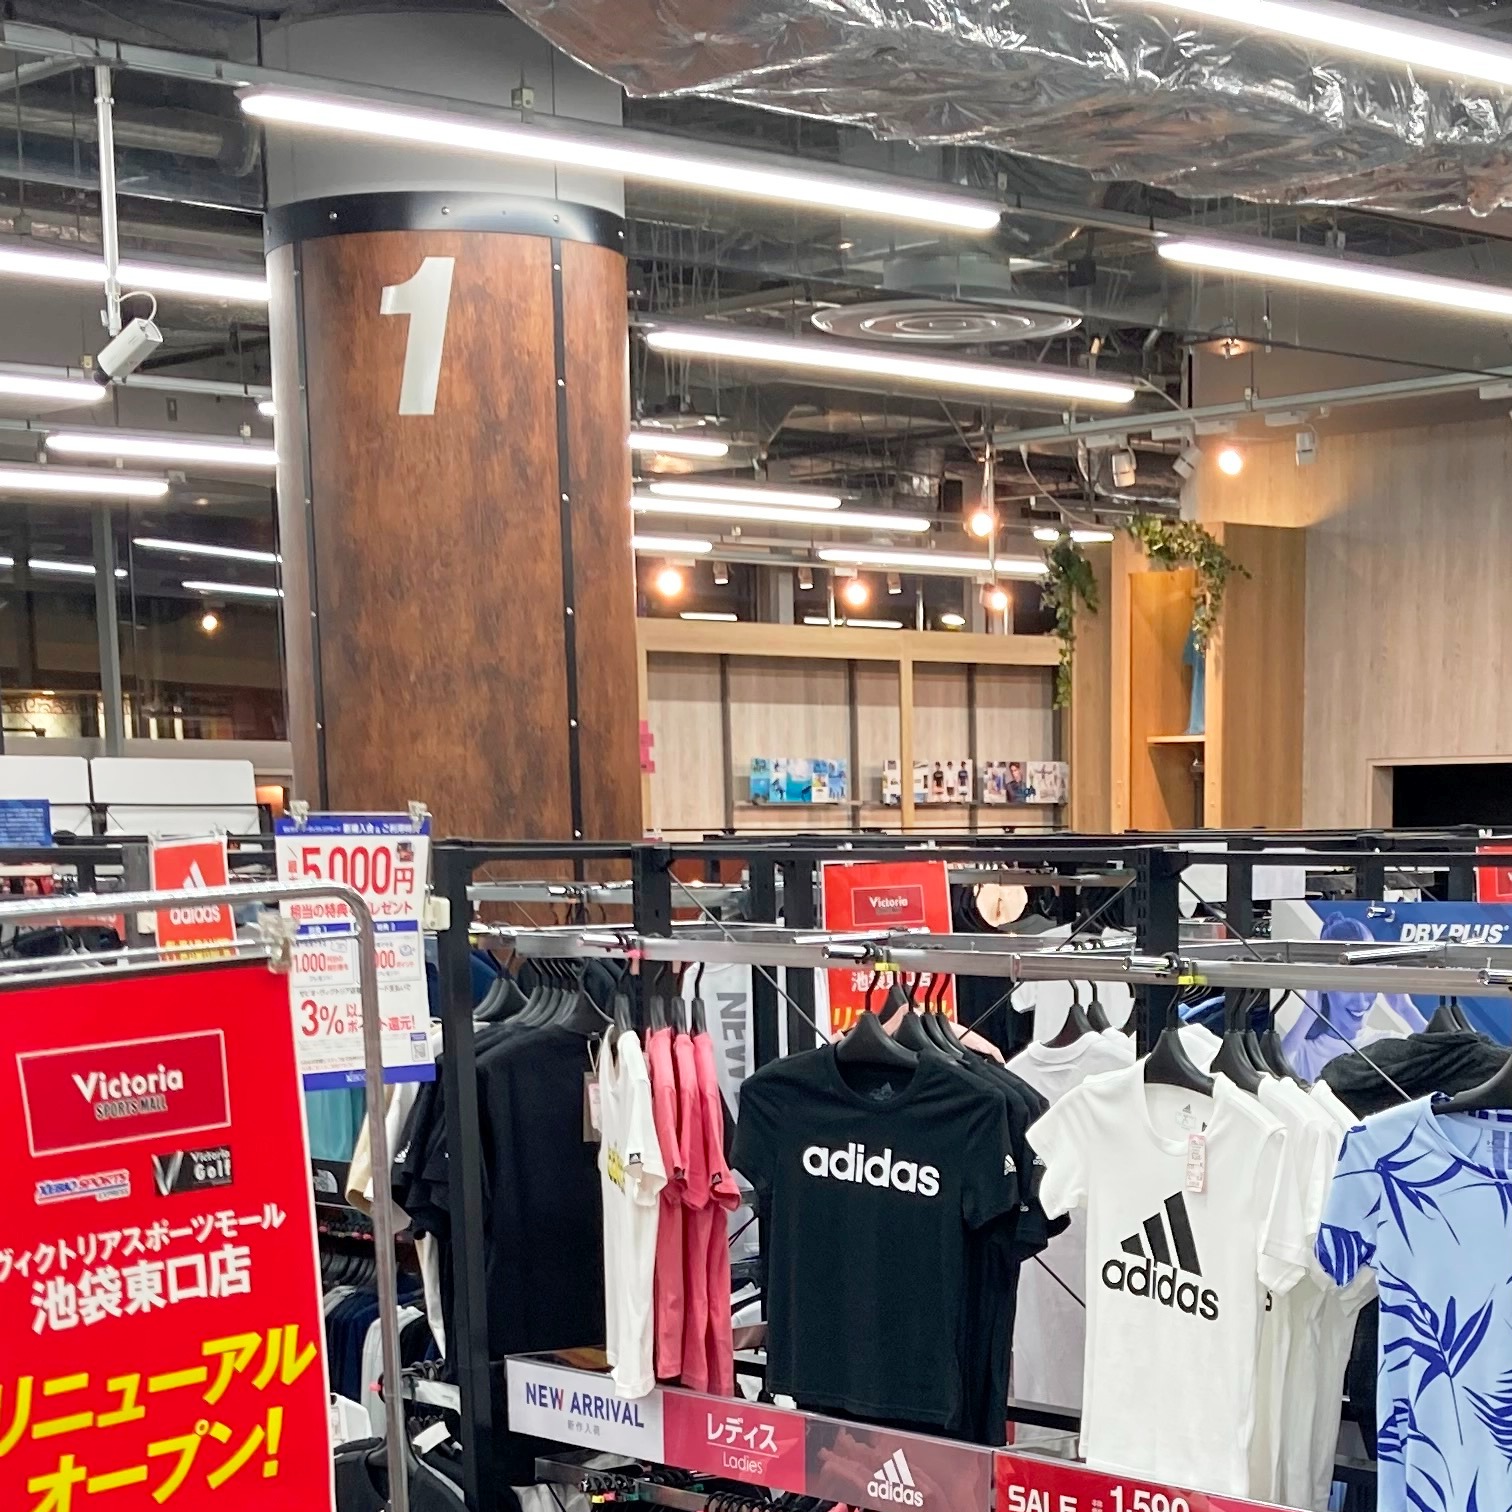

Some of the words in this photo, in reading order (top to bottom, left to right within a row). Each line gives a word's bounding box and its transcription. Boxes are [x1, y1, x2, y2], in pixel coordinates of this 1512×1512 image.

[380, 256, 455, 415] 1
[868, 895, 908, 909] Victoria
[1400, 923, 1447, 942] DRY
[301, 1000, 344, 1036] 3%
[72, 1064, 184, 1103] Victoria
[95, 1097, 138, 1120] SPORTS
[140, 1094, 168, 1113] MALL
[193, 1162, 232, 1182] Golf
[802, 1142, 940, 1197] adidas
[0, 1202, 287, 1283] ヴィクトリアスポーツモール
[31, 1244, 252, 1336] 池袋東口店
[1102, 1258, 1219, 1321] adidas
[525, 1381, 563, 1411] NEW
[569, 1394, 645, 1430] ARRIVAL
[566, 1419, 602, 1437] 新作入荷
[707, 1413, 777, 1452] レディス
[722, 1453, 763, 1476] Ladies
[867, 1477, 924, 1508] adidas
